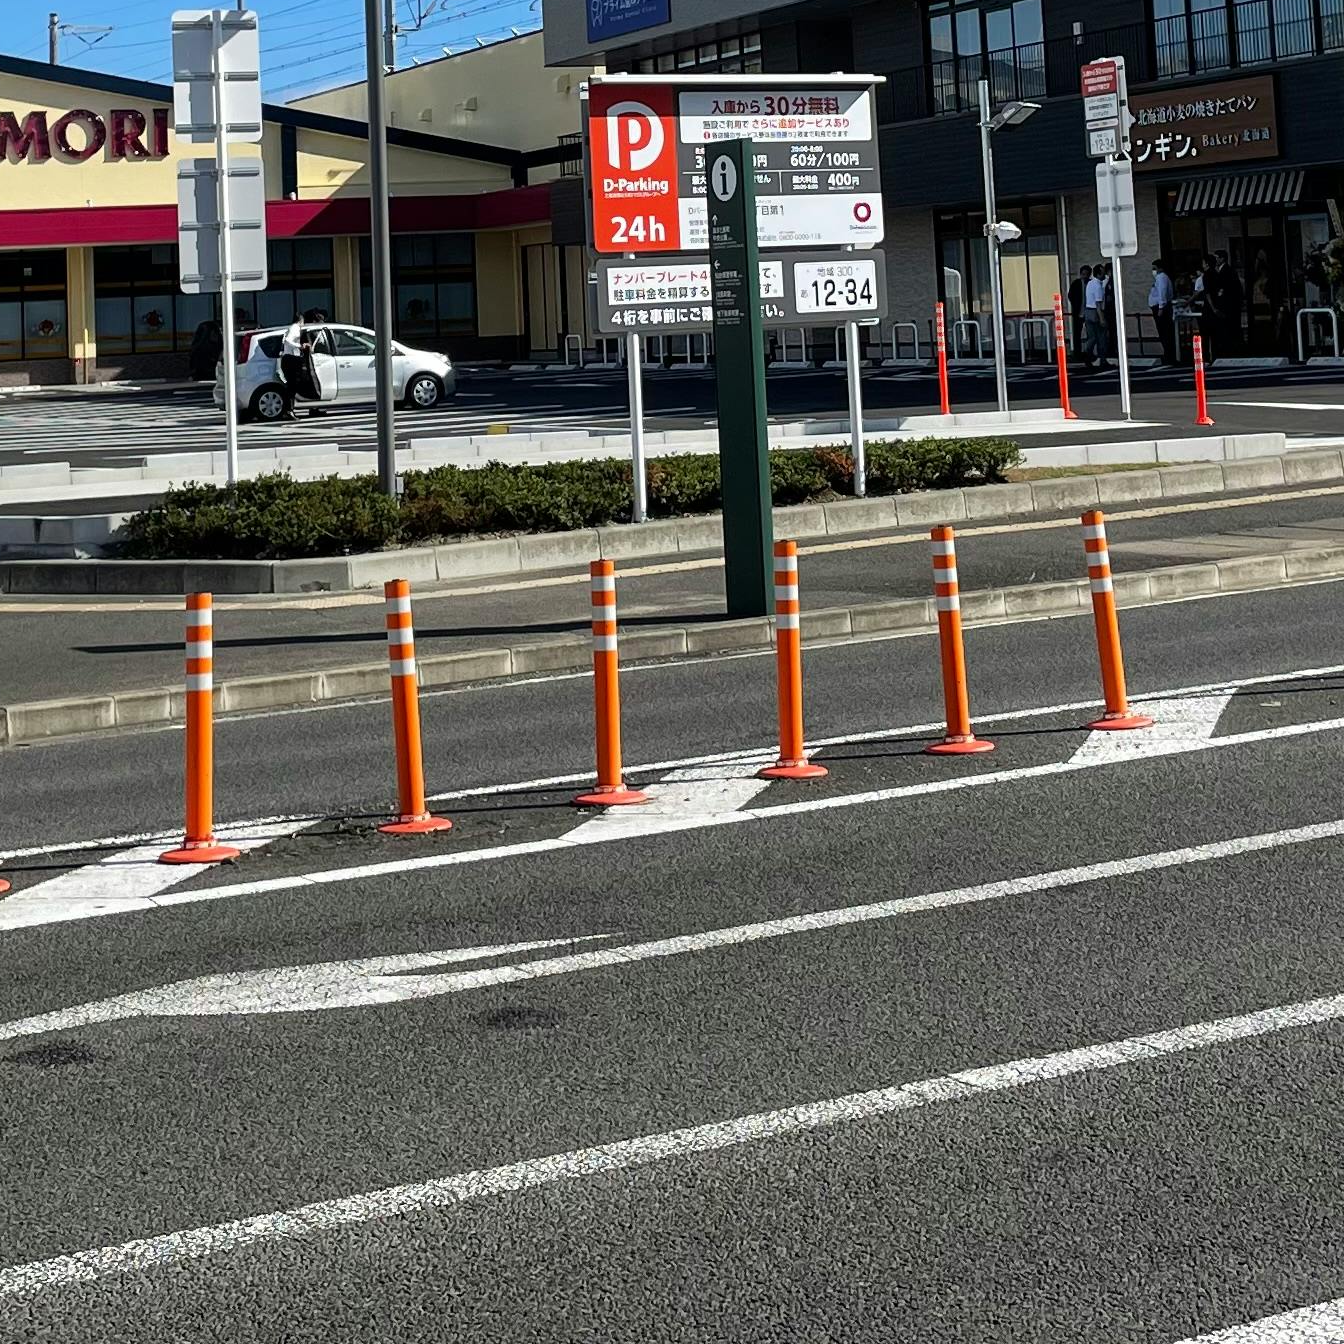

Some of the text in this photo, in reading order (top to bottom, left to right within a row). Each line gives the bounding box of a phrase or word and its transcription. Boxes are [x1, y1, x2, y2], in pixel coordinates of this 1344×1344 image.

[1138, 94, 1258, 126] 北海道小麦の焼きたてパン
[1202, 132, 1240, 147] Bakery
[790, 152, 860, 167] 60分/100円
[603, 177, 669, 194] D-Parking
[827, 173, 860, 187] 400円
[610, 215, 666, 243] 24h
[837, 266, 853, 277] 300
[812, 277, 873, 307] 12-34
